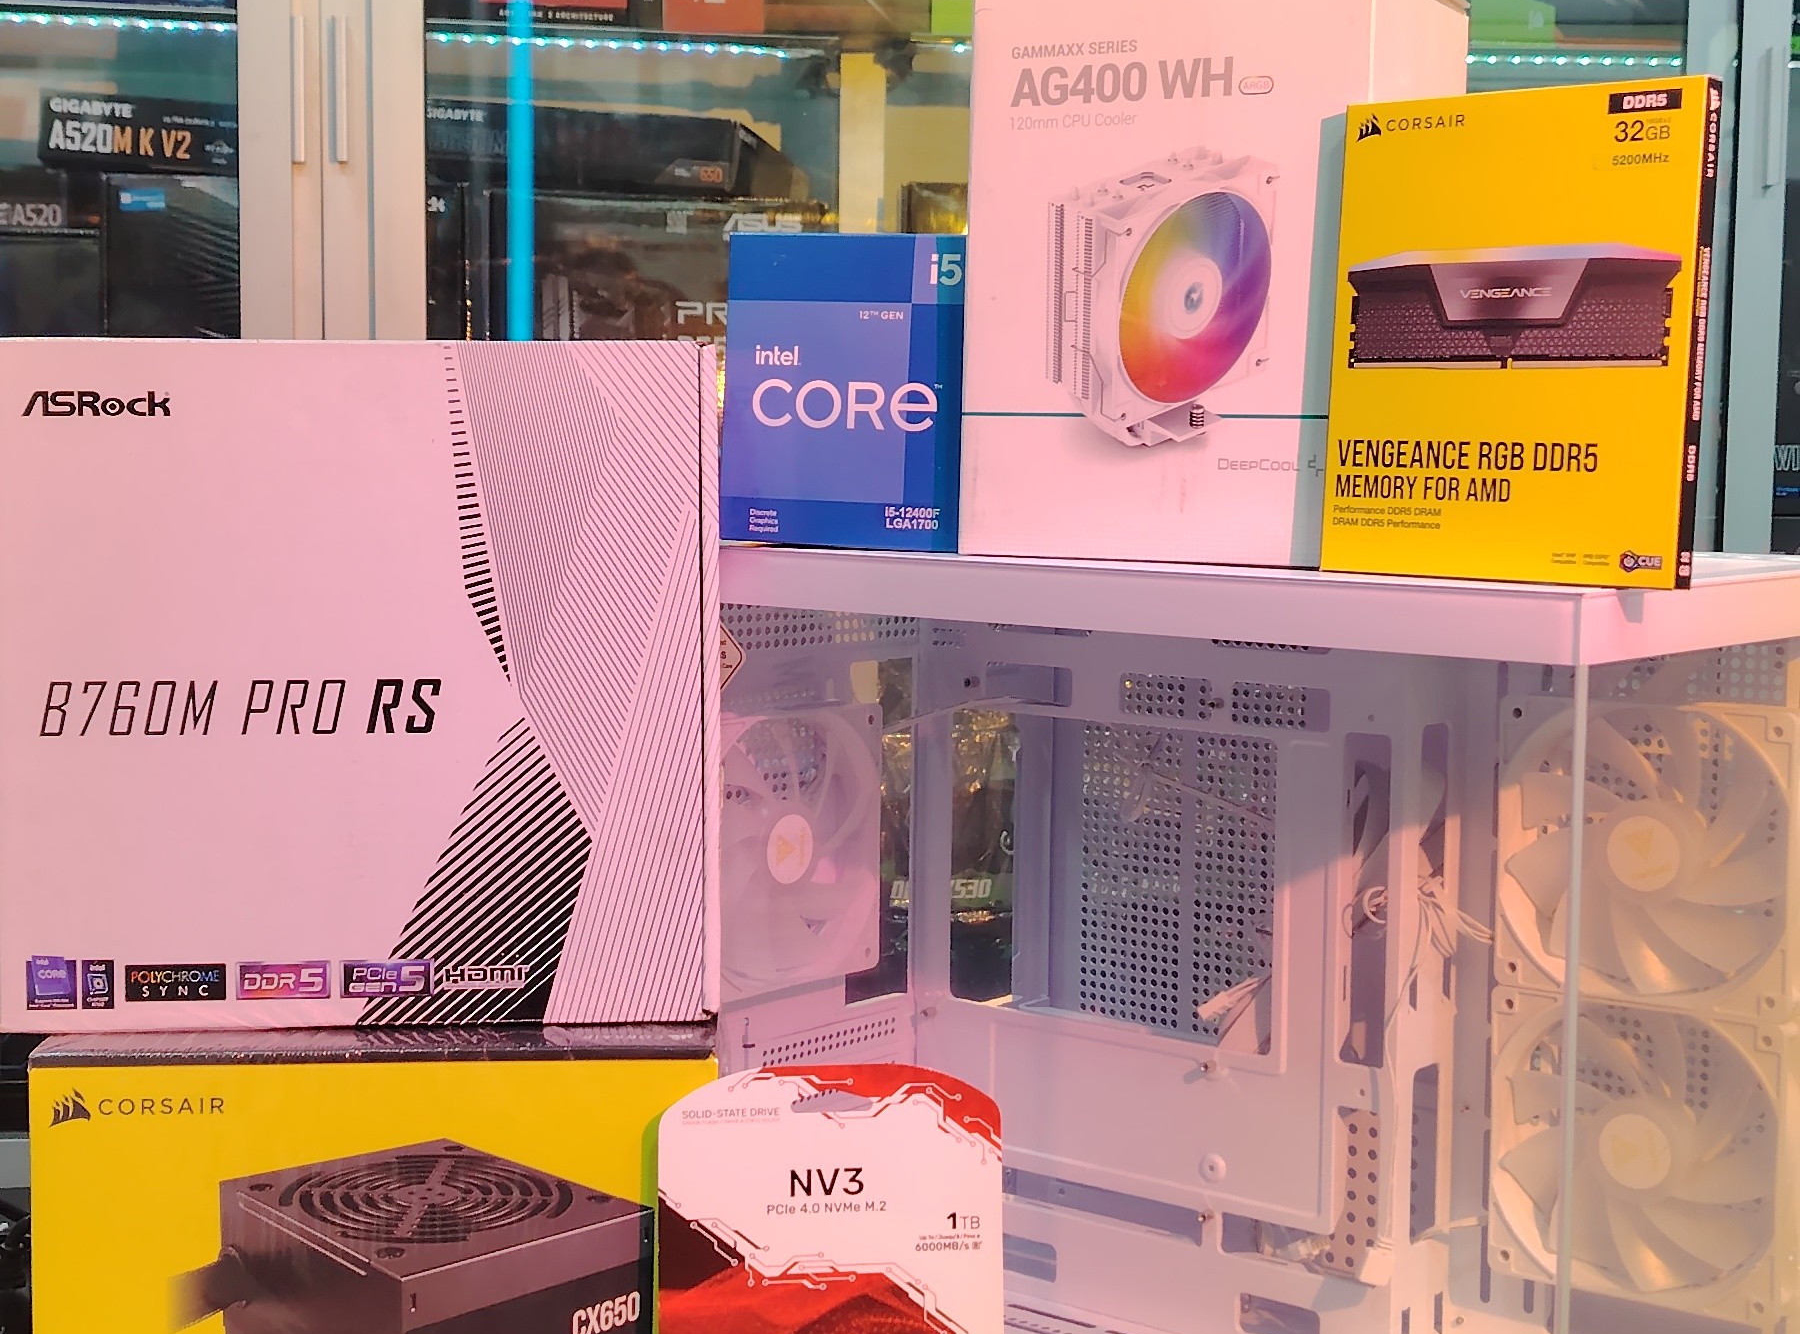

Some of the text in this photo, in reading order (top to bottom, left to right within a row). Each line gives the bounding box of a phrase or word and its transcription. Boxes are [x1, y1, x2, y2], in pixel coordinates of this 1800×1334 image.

[1011, 40, 1138, 60] GAMMAXX SERIES
[1010, 61, 1147, 108] AG400
[1158, 56, 1234, 100] WH
[49, 97, 134, 117] GIGABYTE
[1622, 93, 1668, 110] DDR5
[1010, 111, 1138, 131] 120mm CPU Cooler
[1386, 113, 1466, 133] CORSAIR
[1614, 120, 1670, 142] 32GB
[49, 120, 192, 160] A520M K V2
[1705, 112, 1717, 178] CORSAIR
[1611, 152, 1670, 166] 5200MHz
[13, 204, 62, 226] A520
[723, 213, 803, 241] ASUS
[929, 253, 962, 286] i5
[1459, 286, 1552, 300] VENGEANCE
[880, 311, 904, 320] GEN
[755, 344, 799, 366] intel
[22, 390, 170, 417] ASRock
[1338, 439, 1599, 473] VENGEANCE RGB DDR5
[1335, 474, 1511, 503] MEMORY FOR AMD
[749, 508, 777, 517] Discrete
[749, 517, 778, 525] Graphics
[1333, 505, 1442, 517] Performance DDR5 DRAM
[749, 525, 779, 534] Required
[885, 518, 938, 530] LGA1700
[1332, 517, 1441, 530] DRAM DDR5 Performance
[39, 678, 442, 737] B760M PRO RS
[130, 970, 220, 984] POLYCHROME
[243, 968, 323, 992] DDR5
[352, 967, 397, 980] PCIe
[399, 966, 425, 992] 5
[443, 965, 528, 989] HDMI
[141, 985, 209, 998] SYNC
[98, 1097, 225, 1116] CORSAIR
[682, 1107, 780, 1119] SOLID-STATE DRIVE
[789, 1167, 865, 1197] NV3
[766, 1201, 887, 1216] PCIe 4.0 NVMe M.2
[915, 1241, 969, 1251] 6000MB/s
